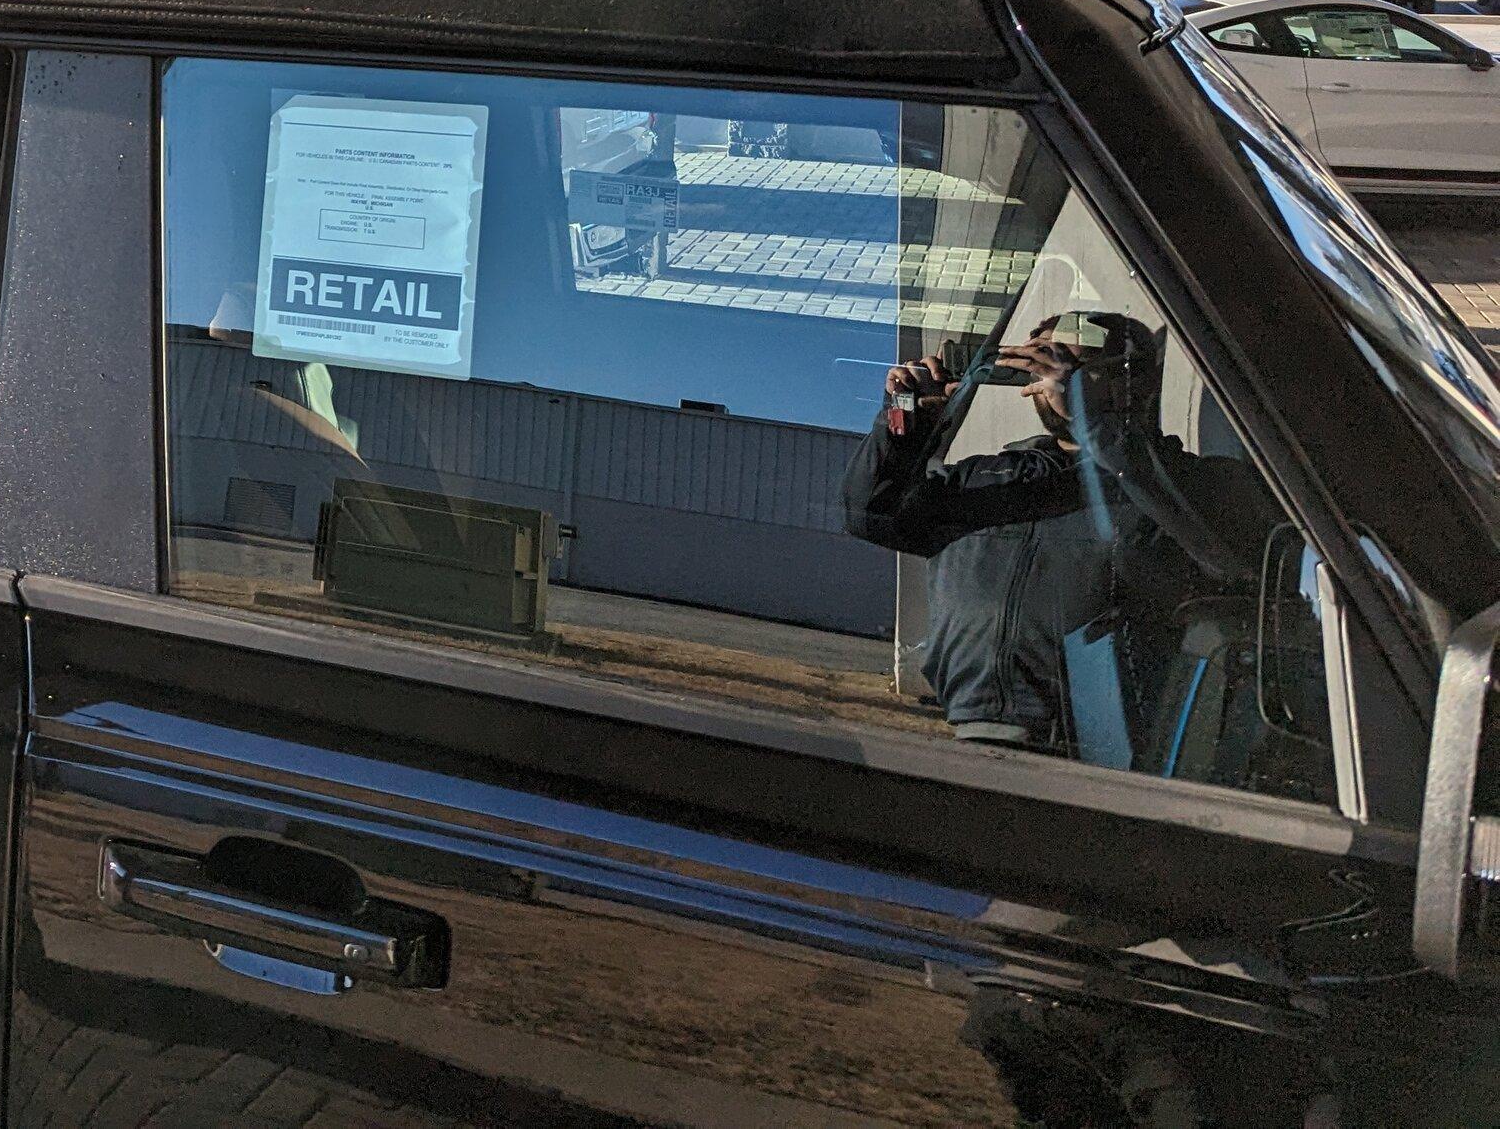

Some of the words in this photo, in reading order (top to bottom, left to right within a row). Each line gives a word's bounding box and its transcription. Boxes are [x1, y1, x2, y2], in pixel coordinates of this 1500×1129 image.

[353, 149, 378, 157] CONTENT
[664, 190, 677, 227] RETAIL
[286, 270, 442, 320] RETAIL
